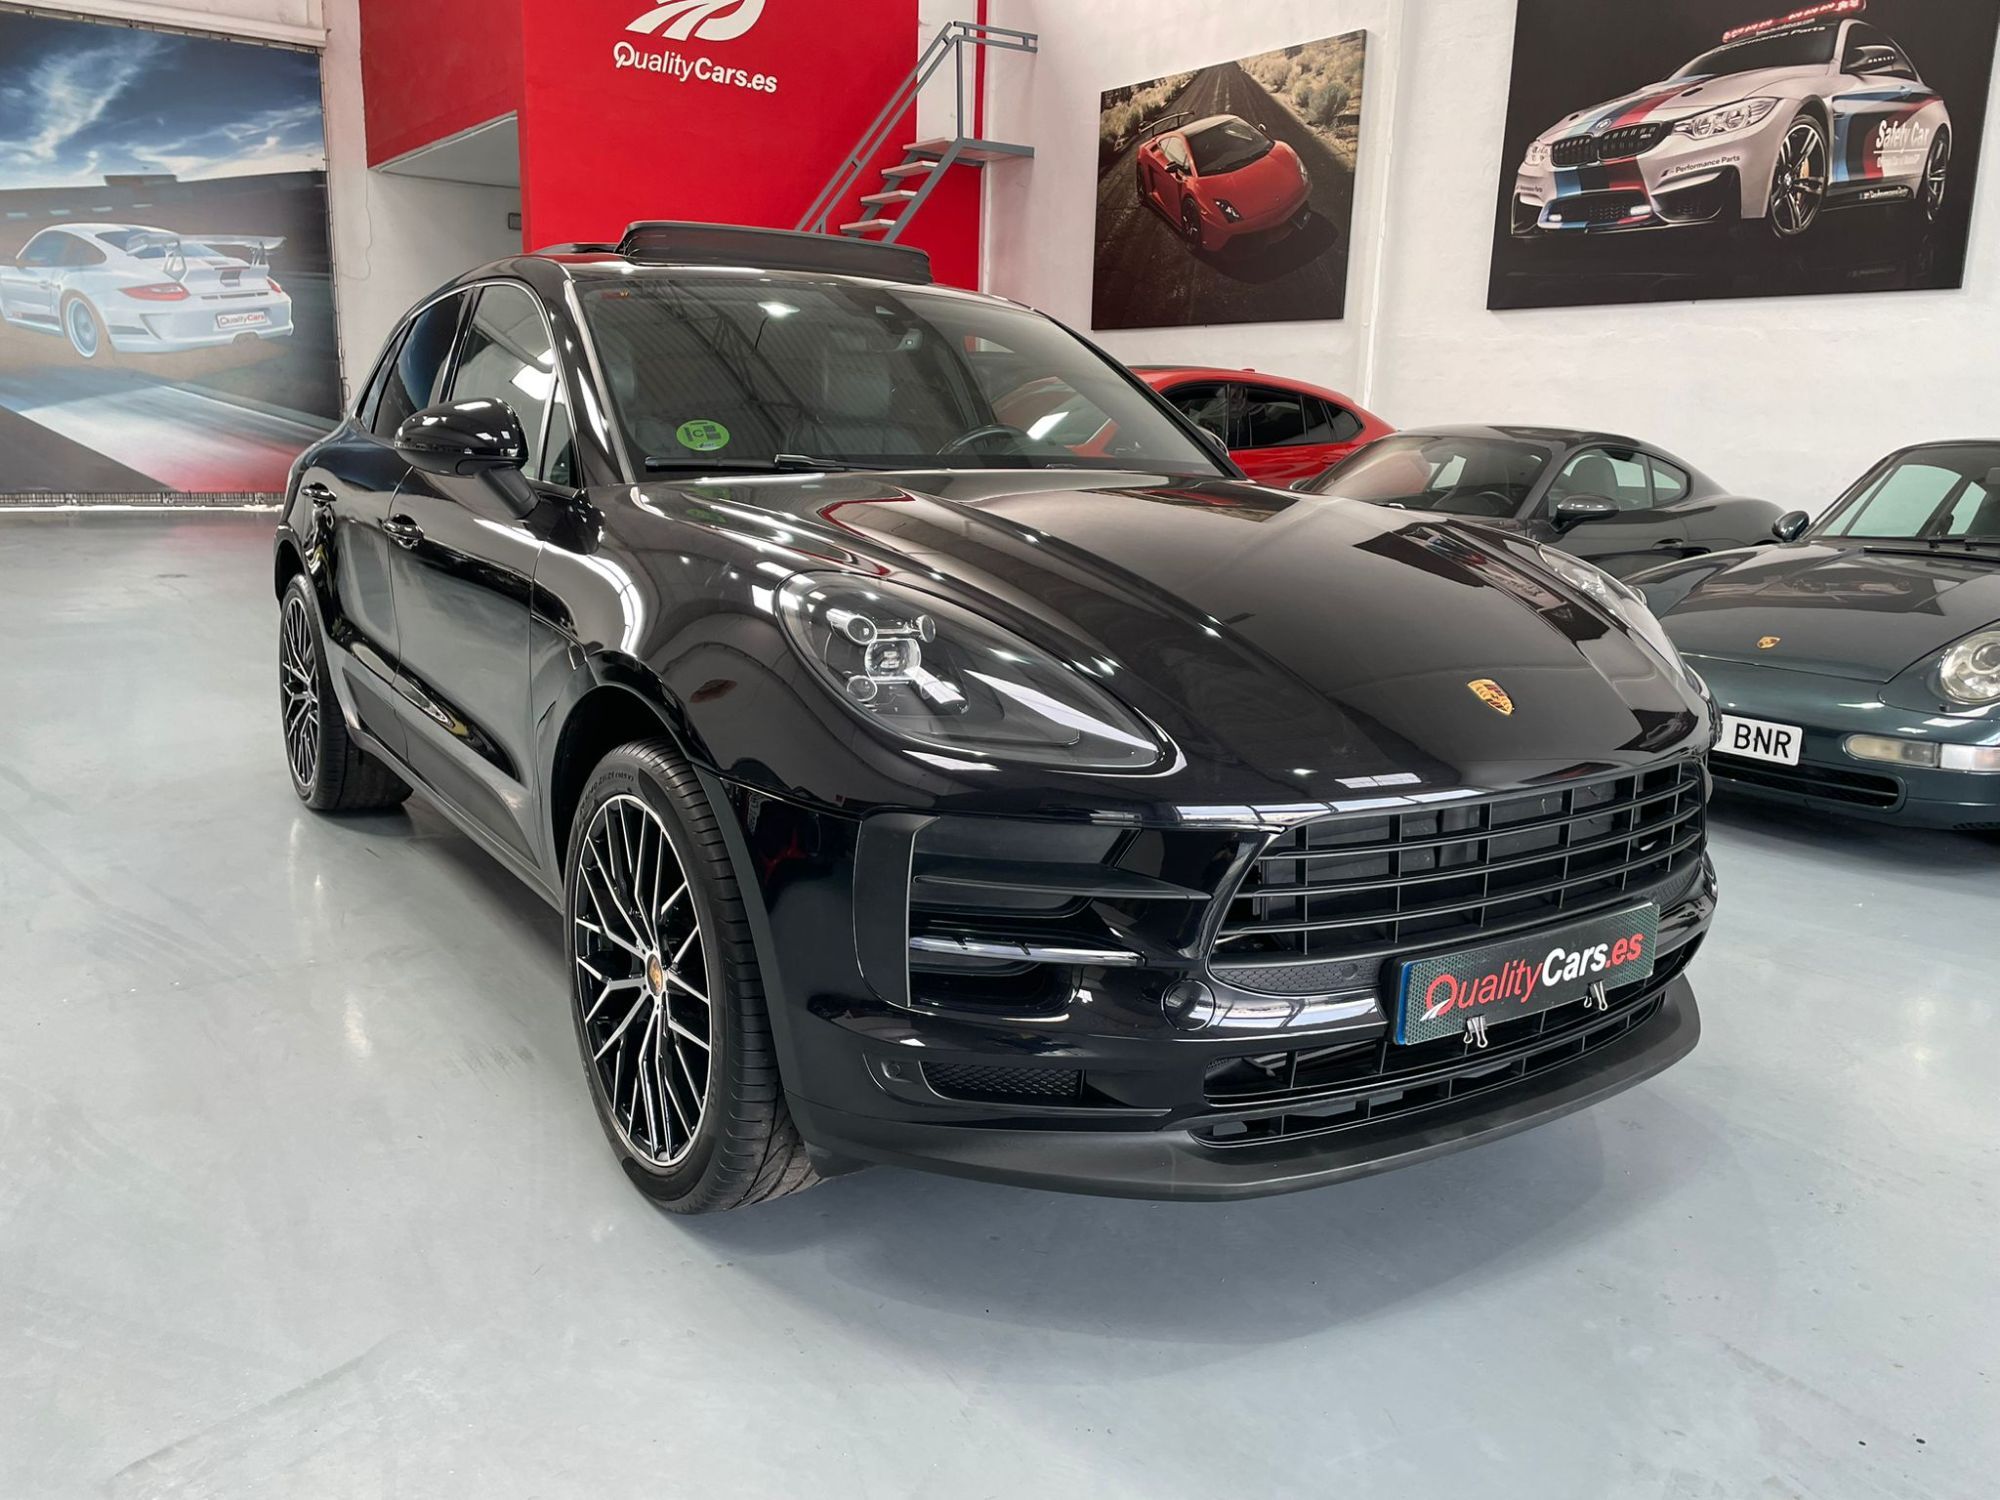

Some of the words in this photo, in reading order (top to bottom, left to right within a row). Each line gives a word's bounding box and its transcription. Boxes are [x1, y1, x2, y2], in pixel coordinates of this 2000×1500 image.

[613, 41, 778, 93] QualityCars.es
[1875, 119, 1910, 150] Safety
[1911, 121, 1930, 147] Car
[1675, 159, 1720, 174] Performance
[1721, 155, 1741, 165] Parts
[1733, 722, 1792, 759] BNR
[1420, 932, 1645, 1022] QualityCars.es
